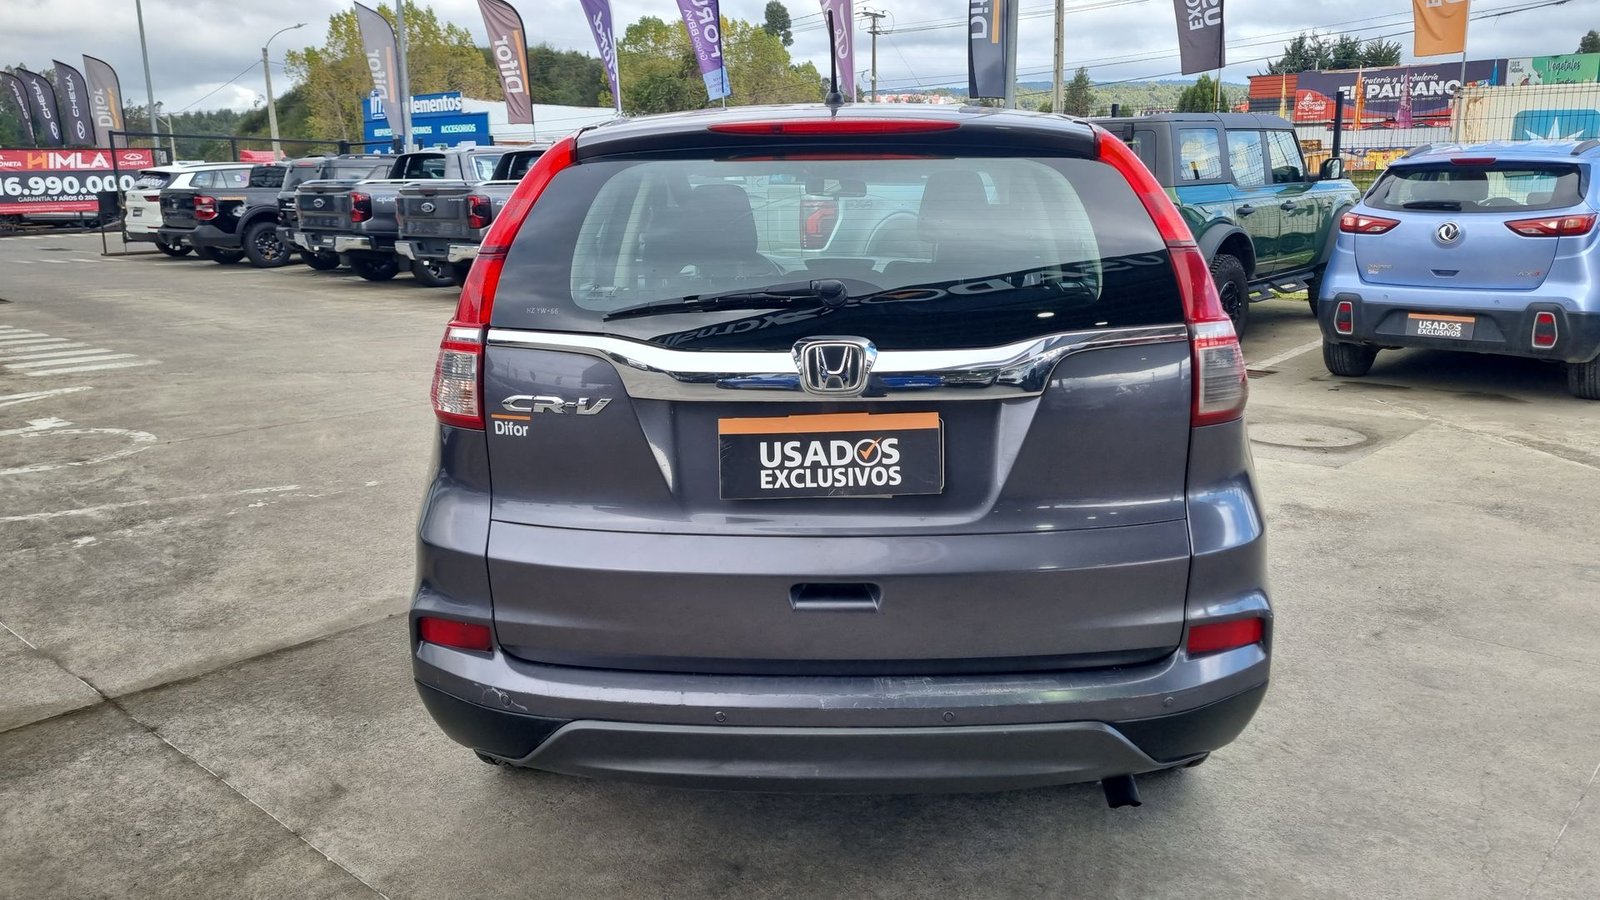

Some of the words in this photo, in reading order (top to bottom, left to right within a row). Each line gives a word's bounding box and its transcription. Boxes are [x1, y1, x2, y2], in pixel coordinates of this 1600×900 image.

[1547, 59, 1581, 75] Vegetales
[441, 124, 476, 134] ACCESORIOS
[27, 152, 110, 169] HIMLA
[1417, 328, 1461, 338] EXCLUSIVOS
[1418, 320, 1462, 331] USADOS
[501, 394, 613, 416] CR-V
[494, 420, 529, 437] Difor
[759, 437, 901, 468] USADOS
[760, 466, 902, 489] EXCLUSIVOS
